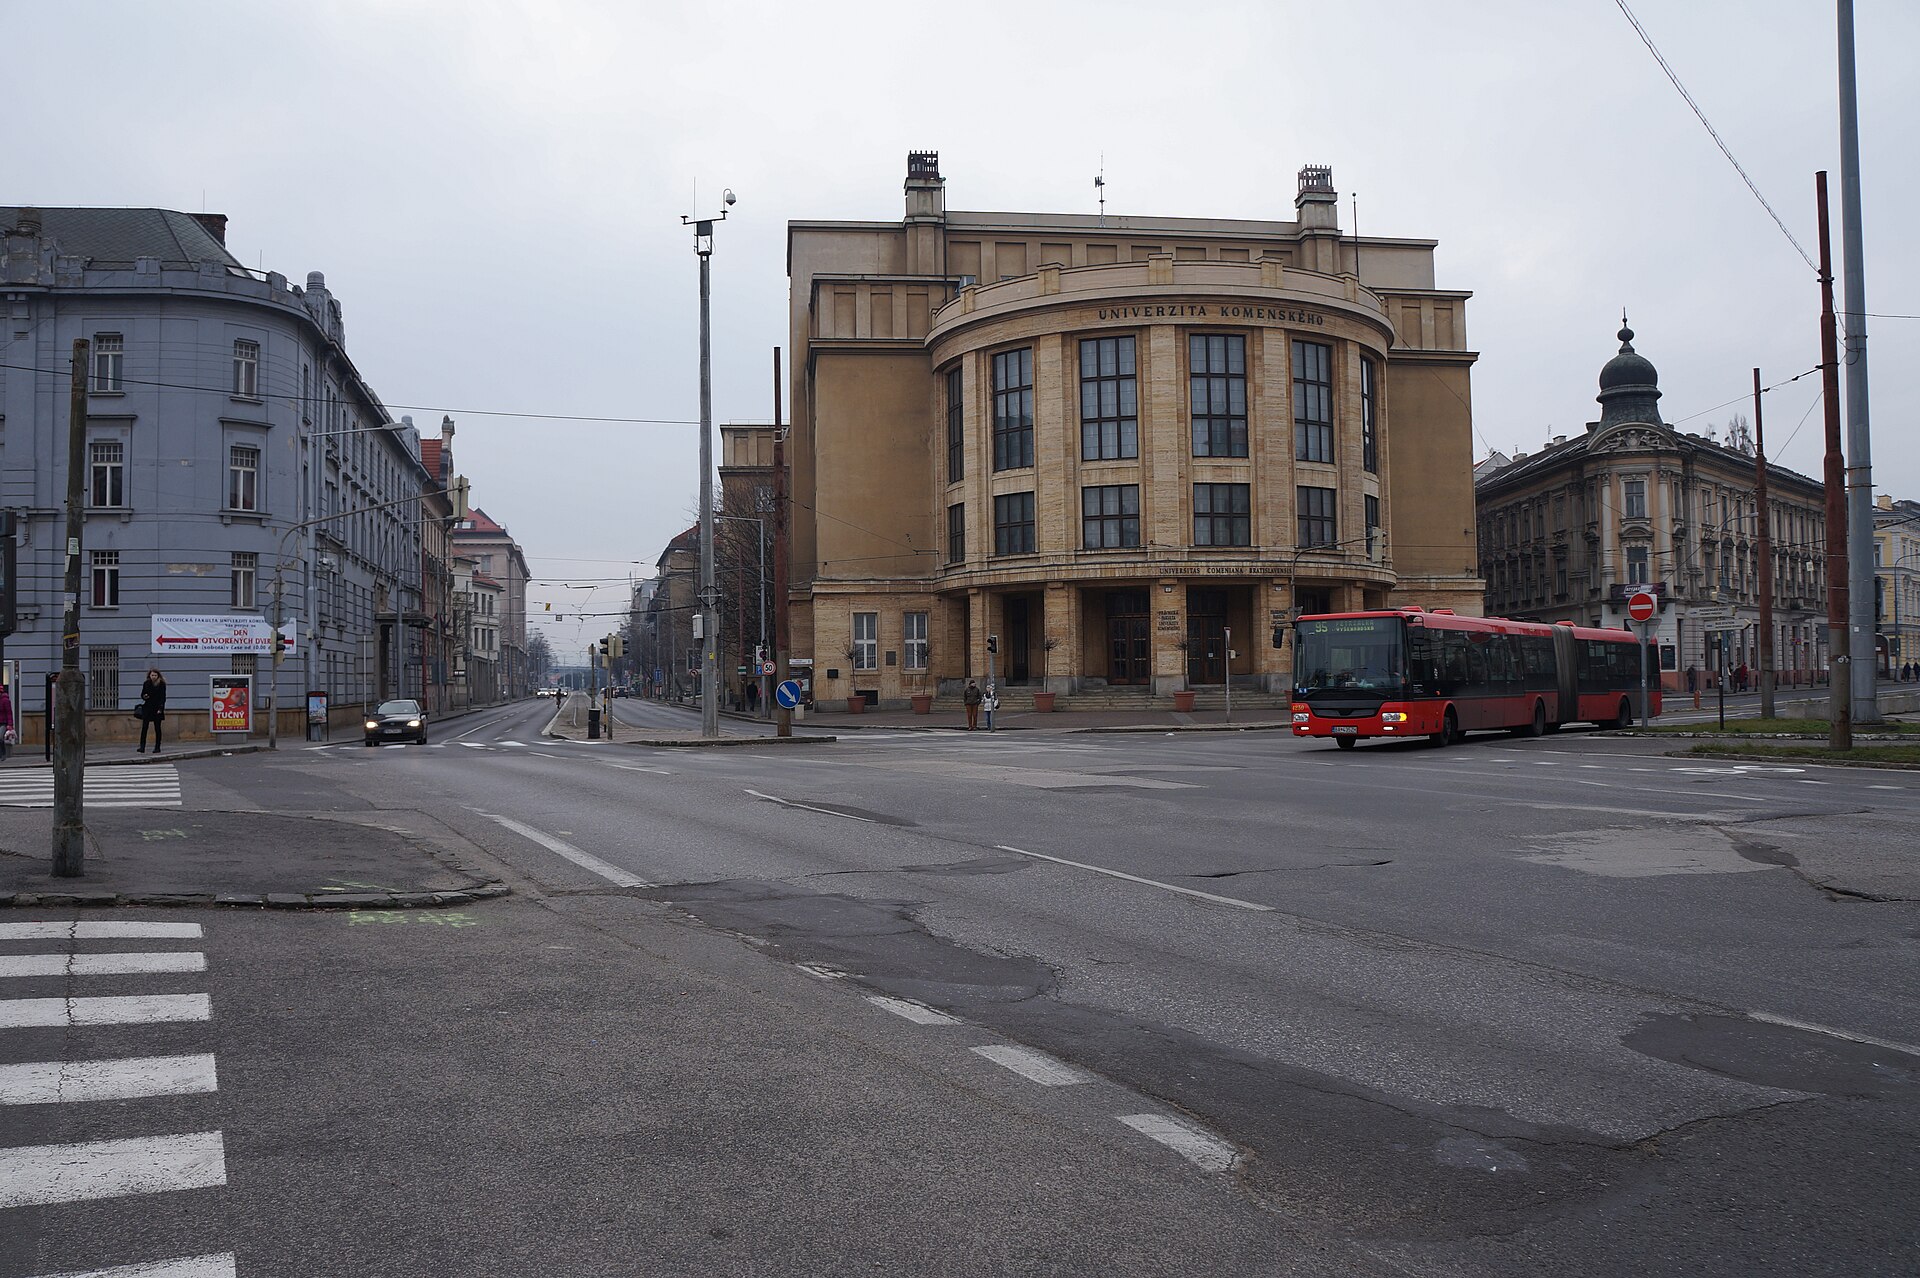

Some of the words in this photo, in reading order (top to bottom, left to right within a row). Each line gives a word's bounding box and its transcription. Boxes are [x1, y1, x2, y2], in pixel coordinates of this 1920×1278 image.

[1098, 305, 1208, 320] UNIVERZITA
[1221, 306, 1323, 325] KOMENSKÉHO
[1315, 621, 1328, 633] 95
[201, 636, 253, 645] OTVORENÝCH
[216, 710, 245, 719] TUČNÝ
